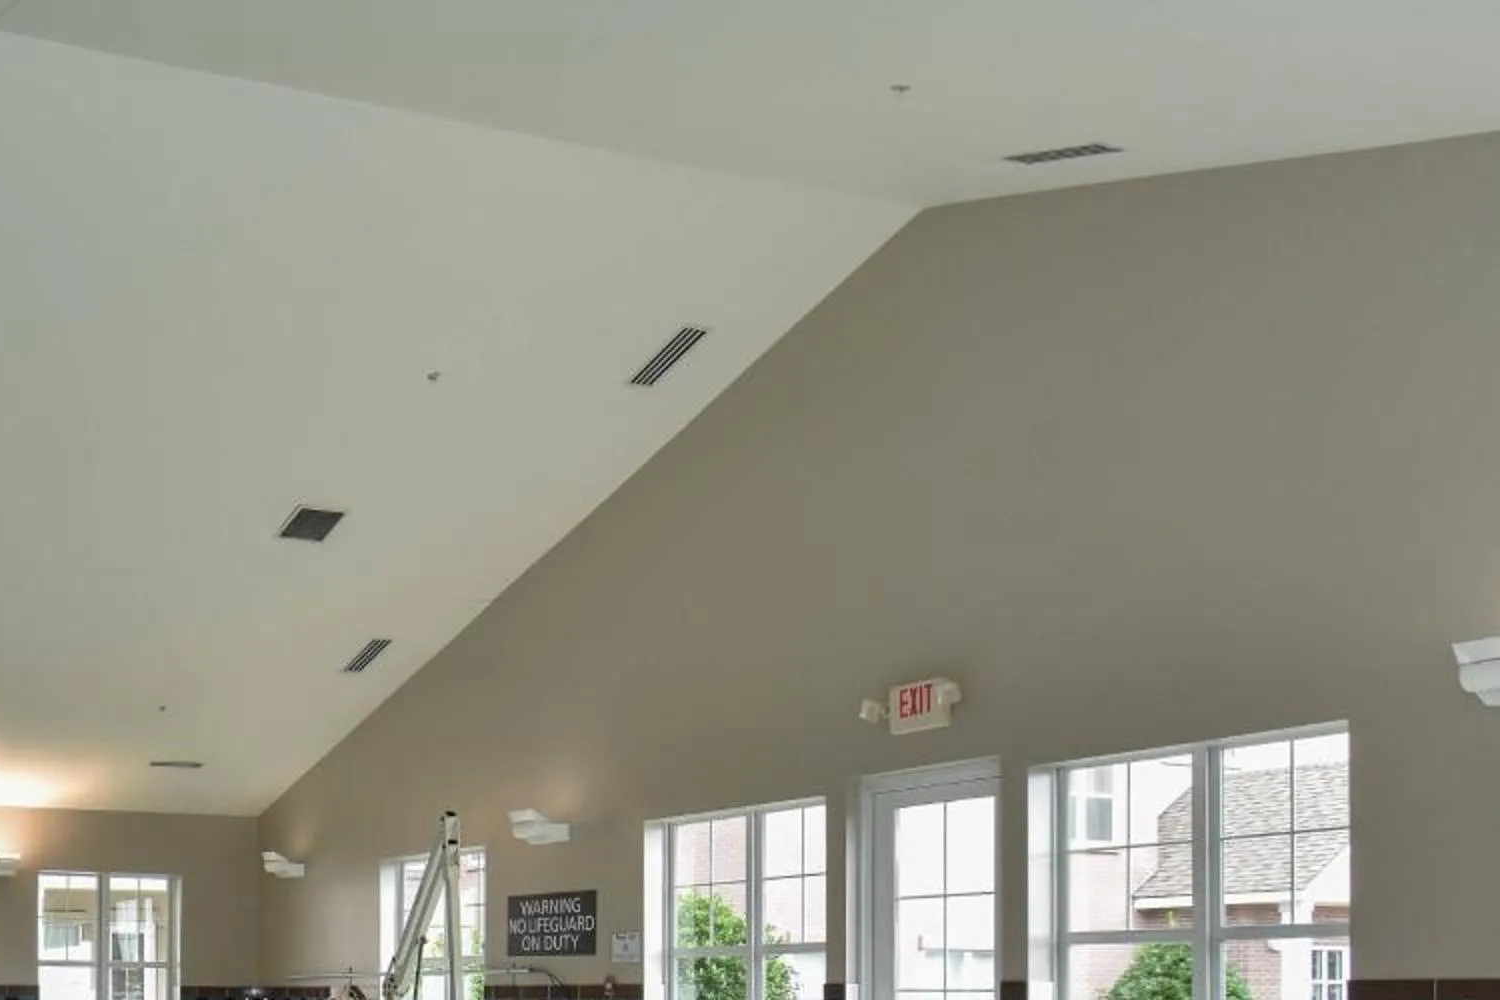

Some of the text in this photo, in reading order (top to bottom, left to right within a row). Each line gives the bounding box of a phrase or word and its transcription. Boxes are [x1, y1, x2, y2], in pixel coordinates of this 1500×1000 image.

[899, 683, 933, 719] EXIT
[520, 898, 581, 916] WARNING
[509, 915, 595, 934] NO LIFEGUARD
[521, 934, 581, 951] ON DUTY
